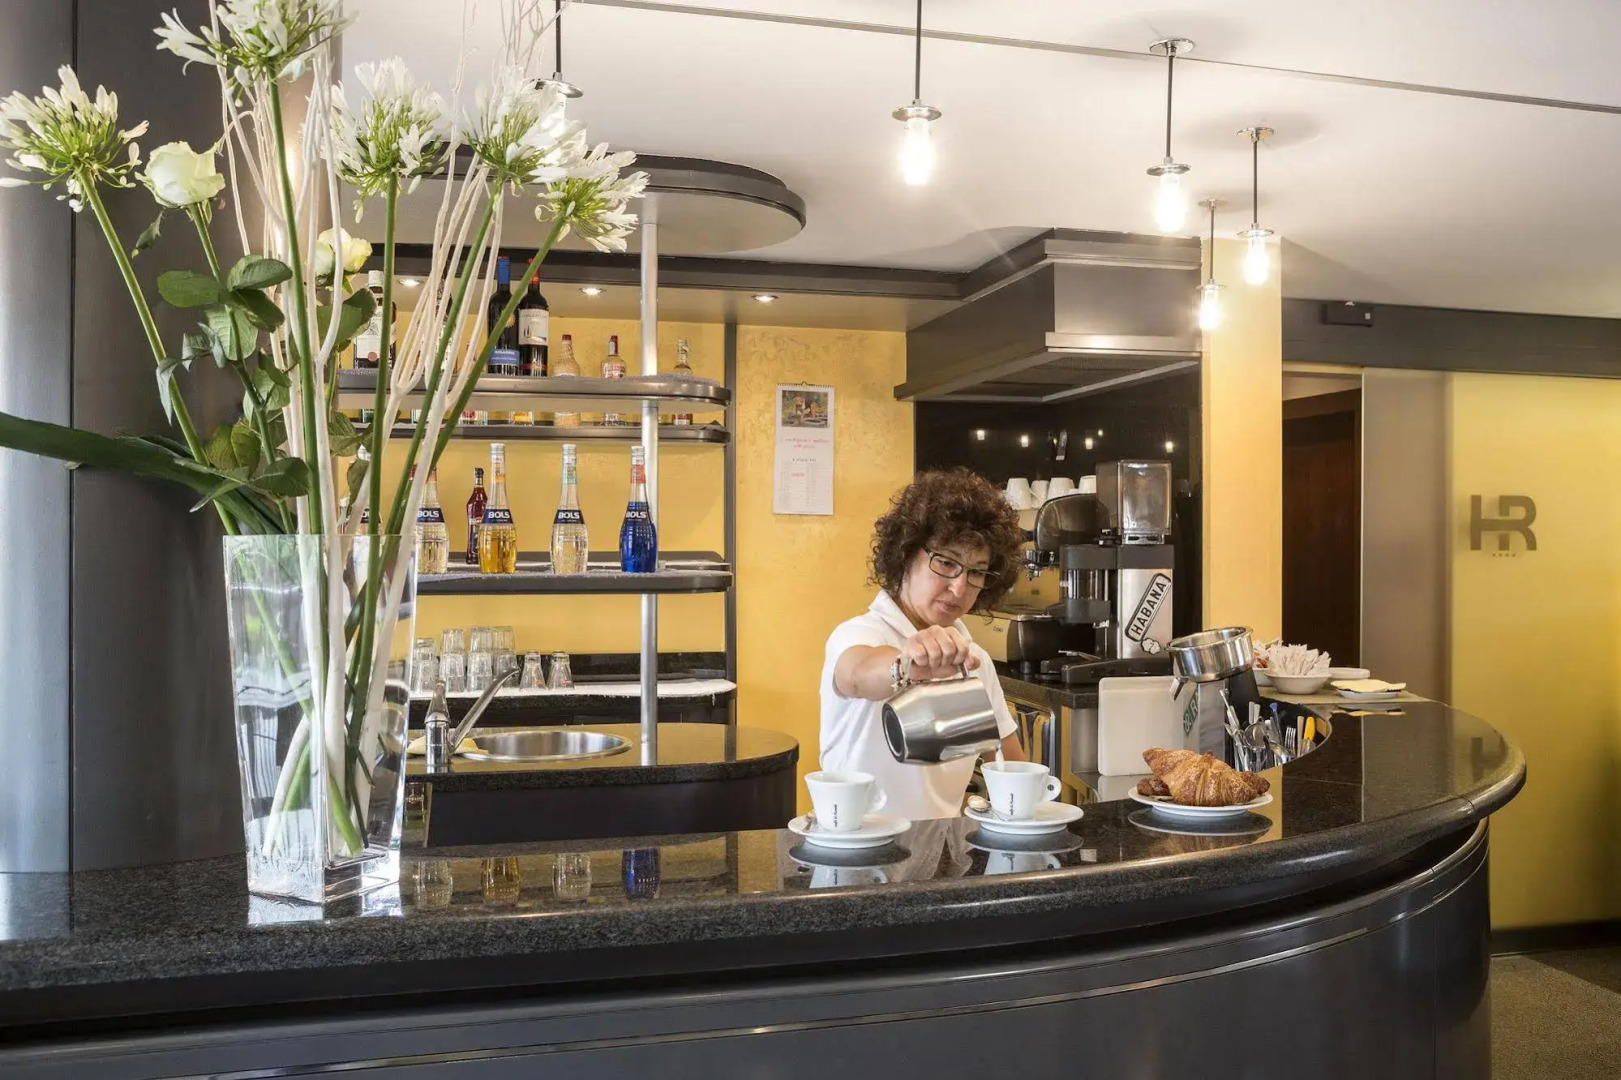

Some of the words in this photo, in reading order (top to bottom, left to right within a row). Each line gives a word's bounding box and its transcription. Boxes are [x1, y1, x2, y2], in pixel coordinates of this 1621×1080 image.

[417, 510, 440, 518] BOLS
[488, 511, 510, 519] BOLS
[558, 511, 580, 519] BOLS
[625, 511, 647, 519] BOLS
[1470, 495, 1537, 551] HR
[1130, 581, 1167, 636] HABANA
